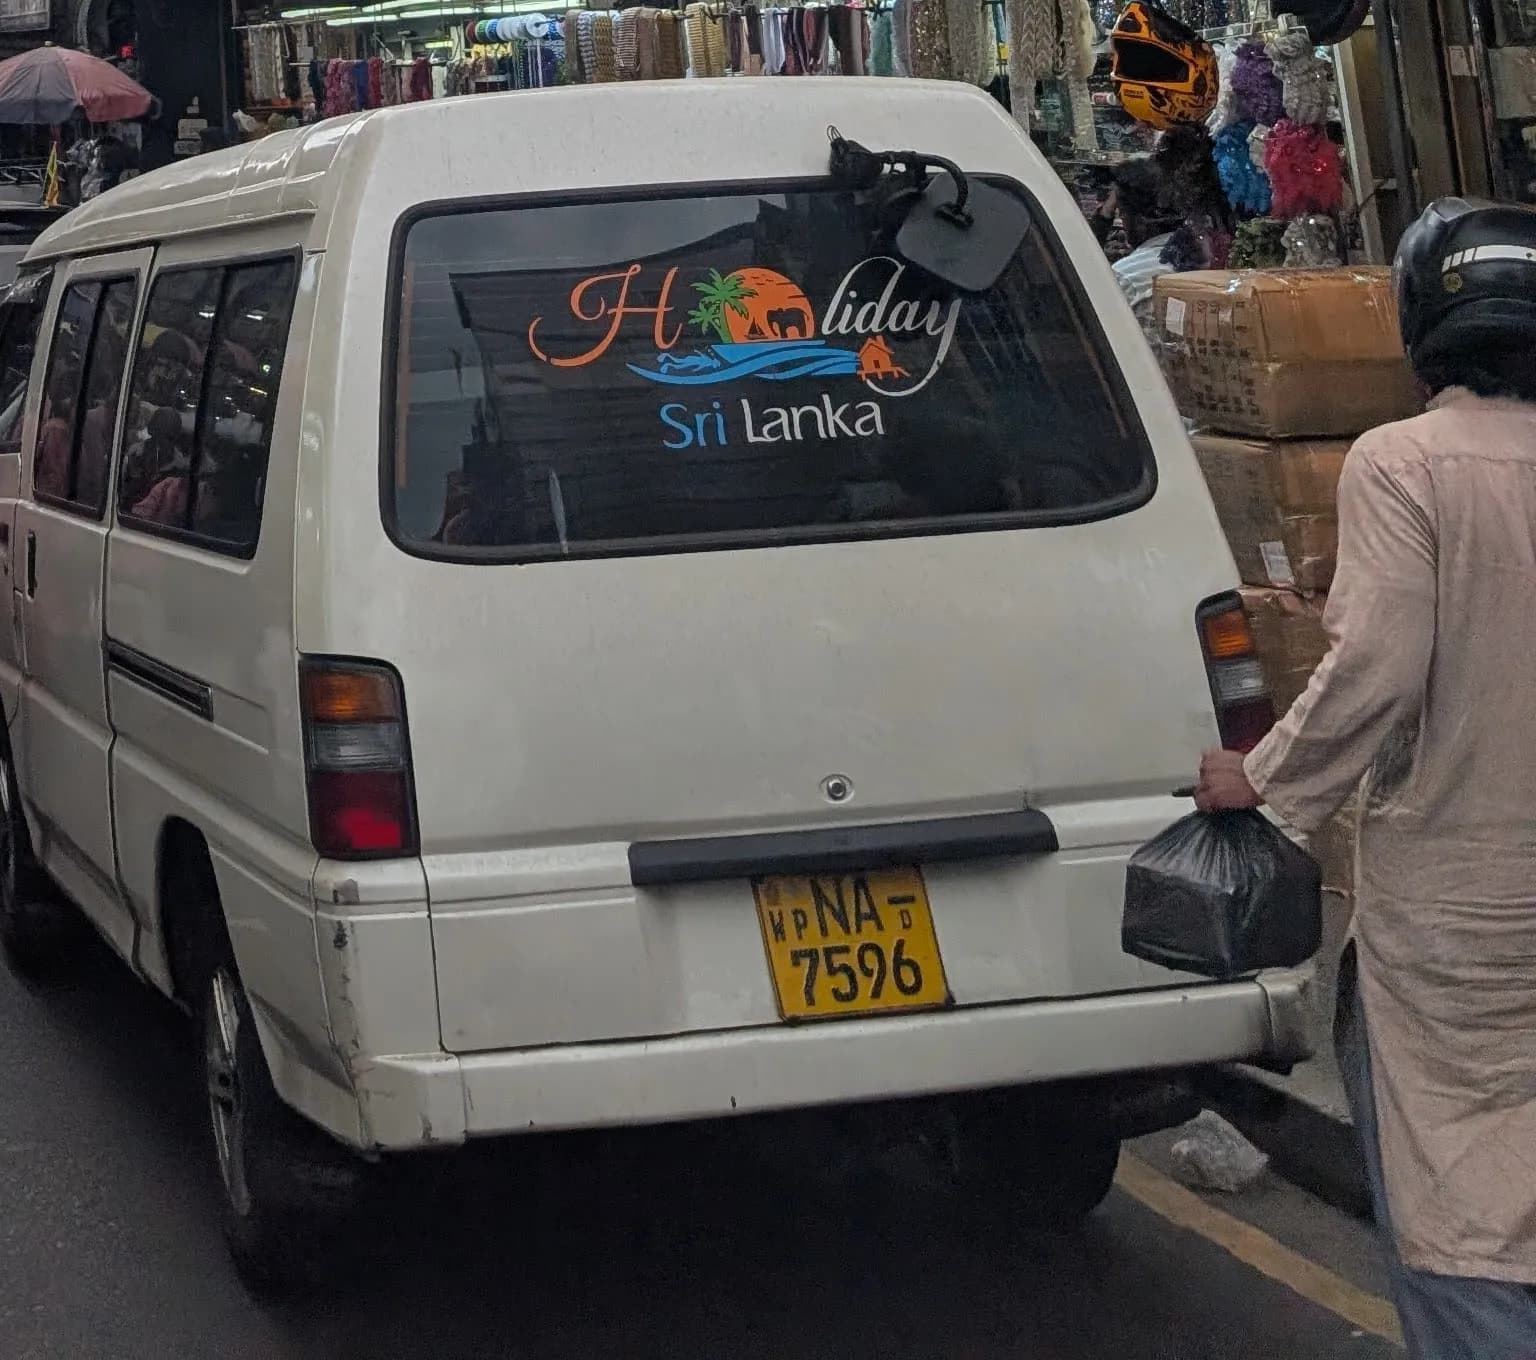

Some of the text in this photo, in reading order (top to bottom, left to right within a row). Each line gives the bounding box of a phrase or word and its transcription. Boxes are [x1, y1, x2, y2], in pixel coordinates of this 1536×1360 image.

[658, 392, 886, 450] Sri Lanka
[789, 938, 923, 1007] 7596
